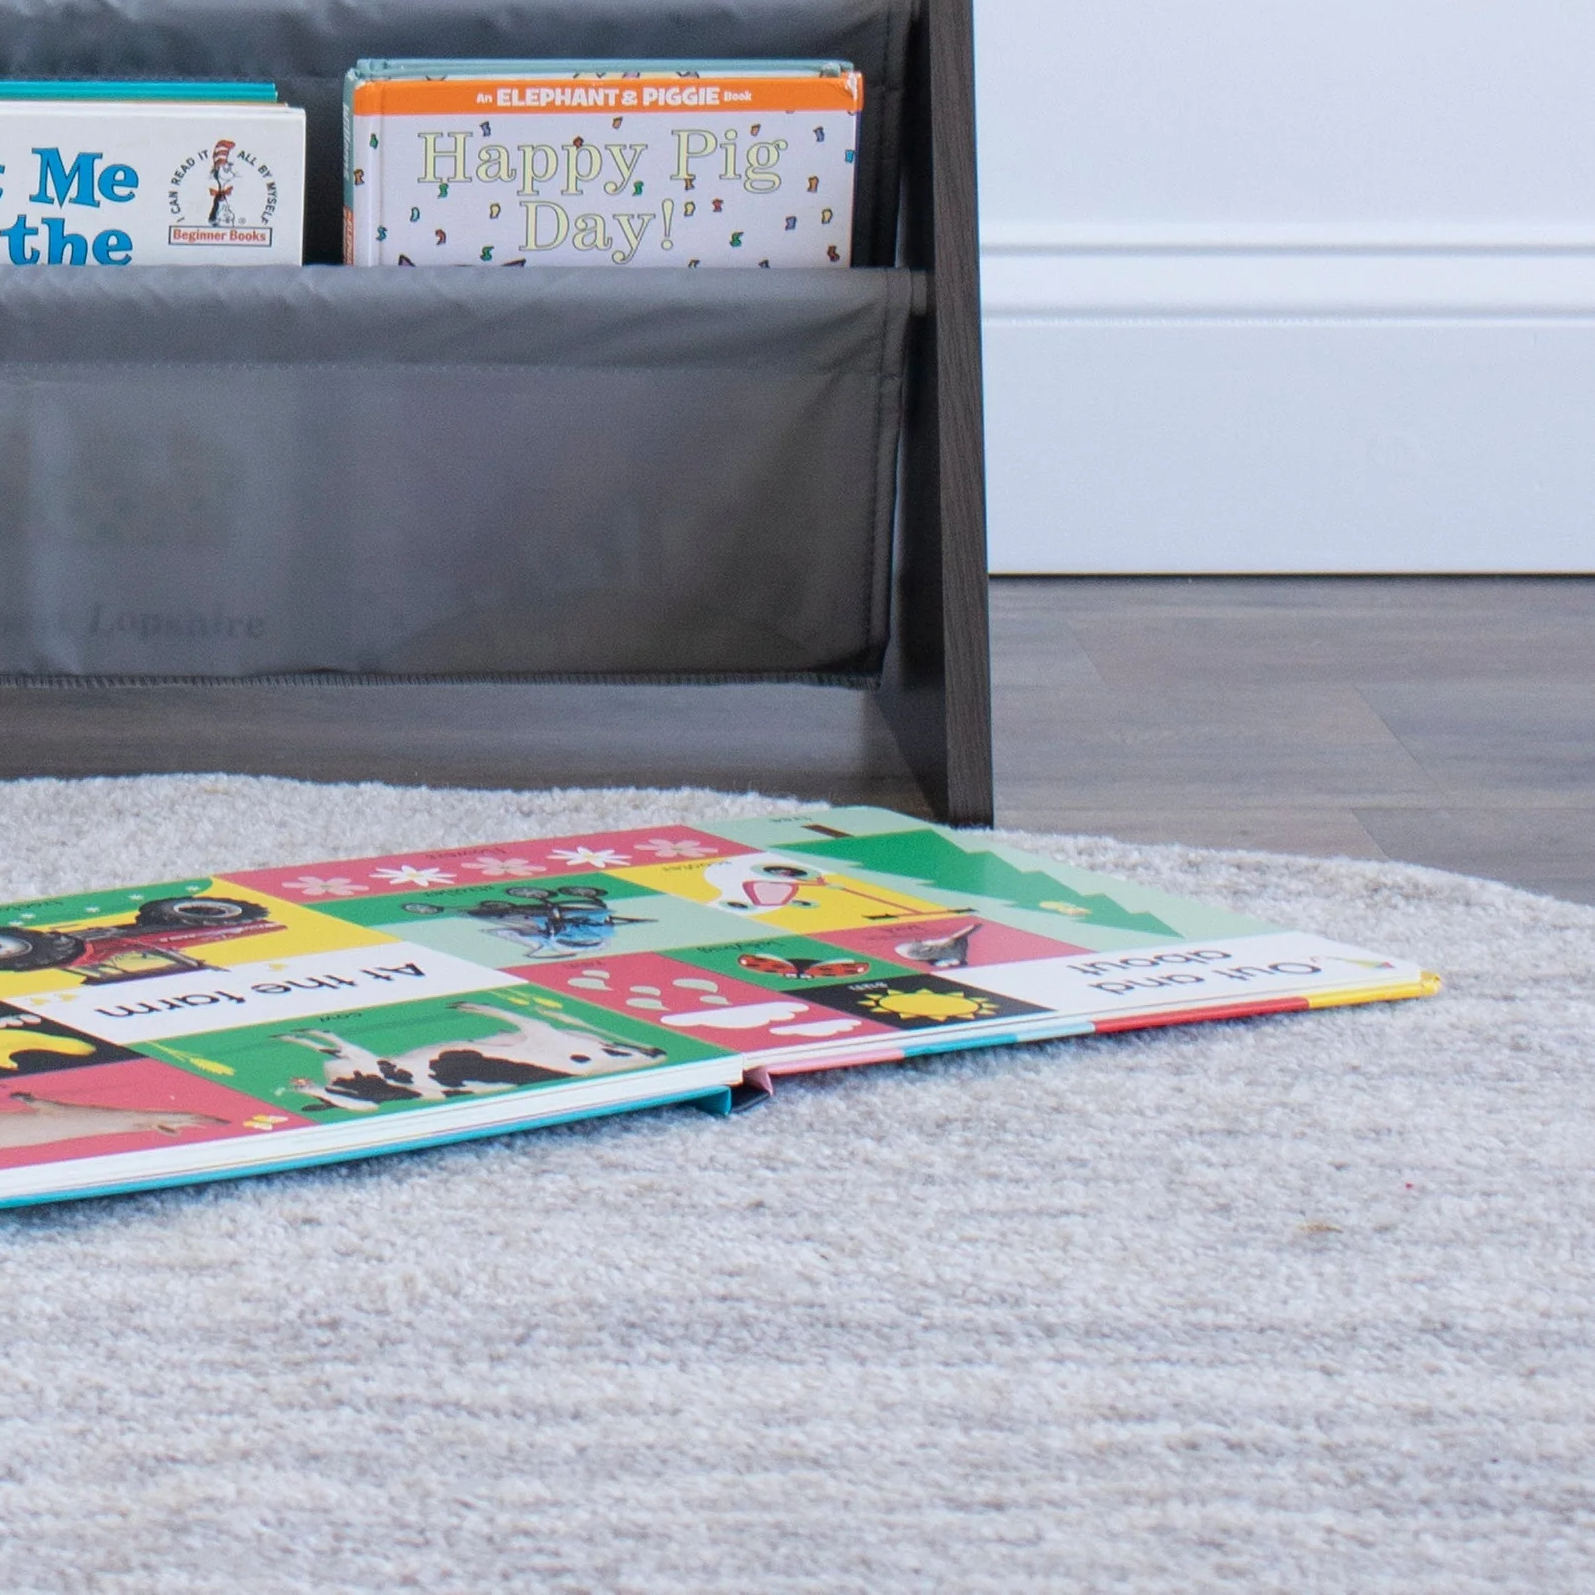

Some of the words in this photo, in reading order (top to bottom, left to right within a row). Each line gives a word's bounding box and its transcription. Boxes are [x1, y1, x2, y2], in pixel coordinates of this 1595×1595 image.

[476, 92, 493, 105] An
[496, 86, 619, 107] ELEPHANT
[620, 90, 637, 107] &
[642, 86, 721, 107] PIGGIE
[723, 89, 752, 104] Book
[197, 149, 210, 162] IT
[237, 150, 257, 167] ALL
[417, 131, 648, 197] Happy
[669, 128, 789, 195] Pig
[29, 146, 140, 210] Me
[170, 157, 196, 186] READ
[257, 164, 273, 179] BY
[168, 190, 181, 215] CAN
[261, 181, 278, 225] MYSELF
[0, 212, 134, 265] the
[173, 228, 227, 242] Beginner
[229, 229, 267, 242] Books
[518, 198, 675, 266] Day!
[359, 962, 426, 982] At
[1066, 948, 1233, 977] about
[1212, 961, 1323, 982] Out
[251, 974, 359, 994] the
[1087, 973, 1206, 996] and
[95, 990, 247, 1018] farm
